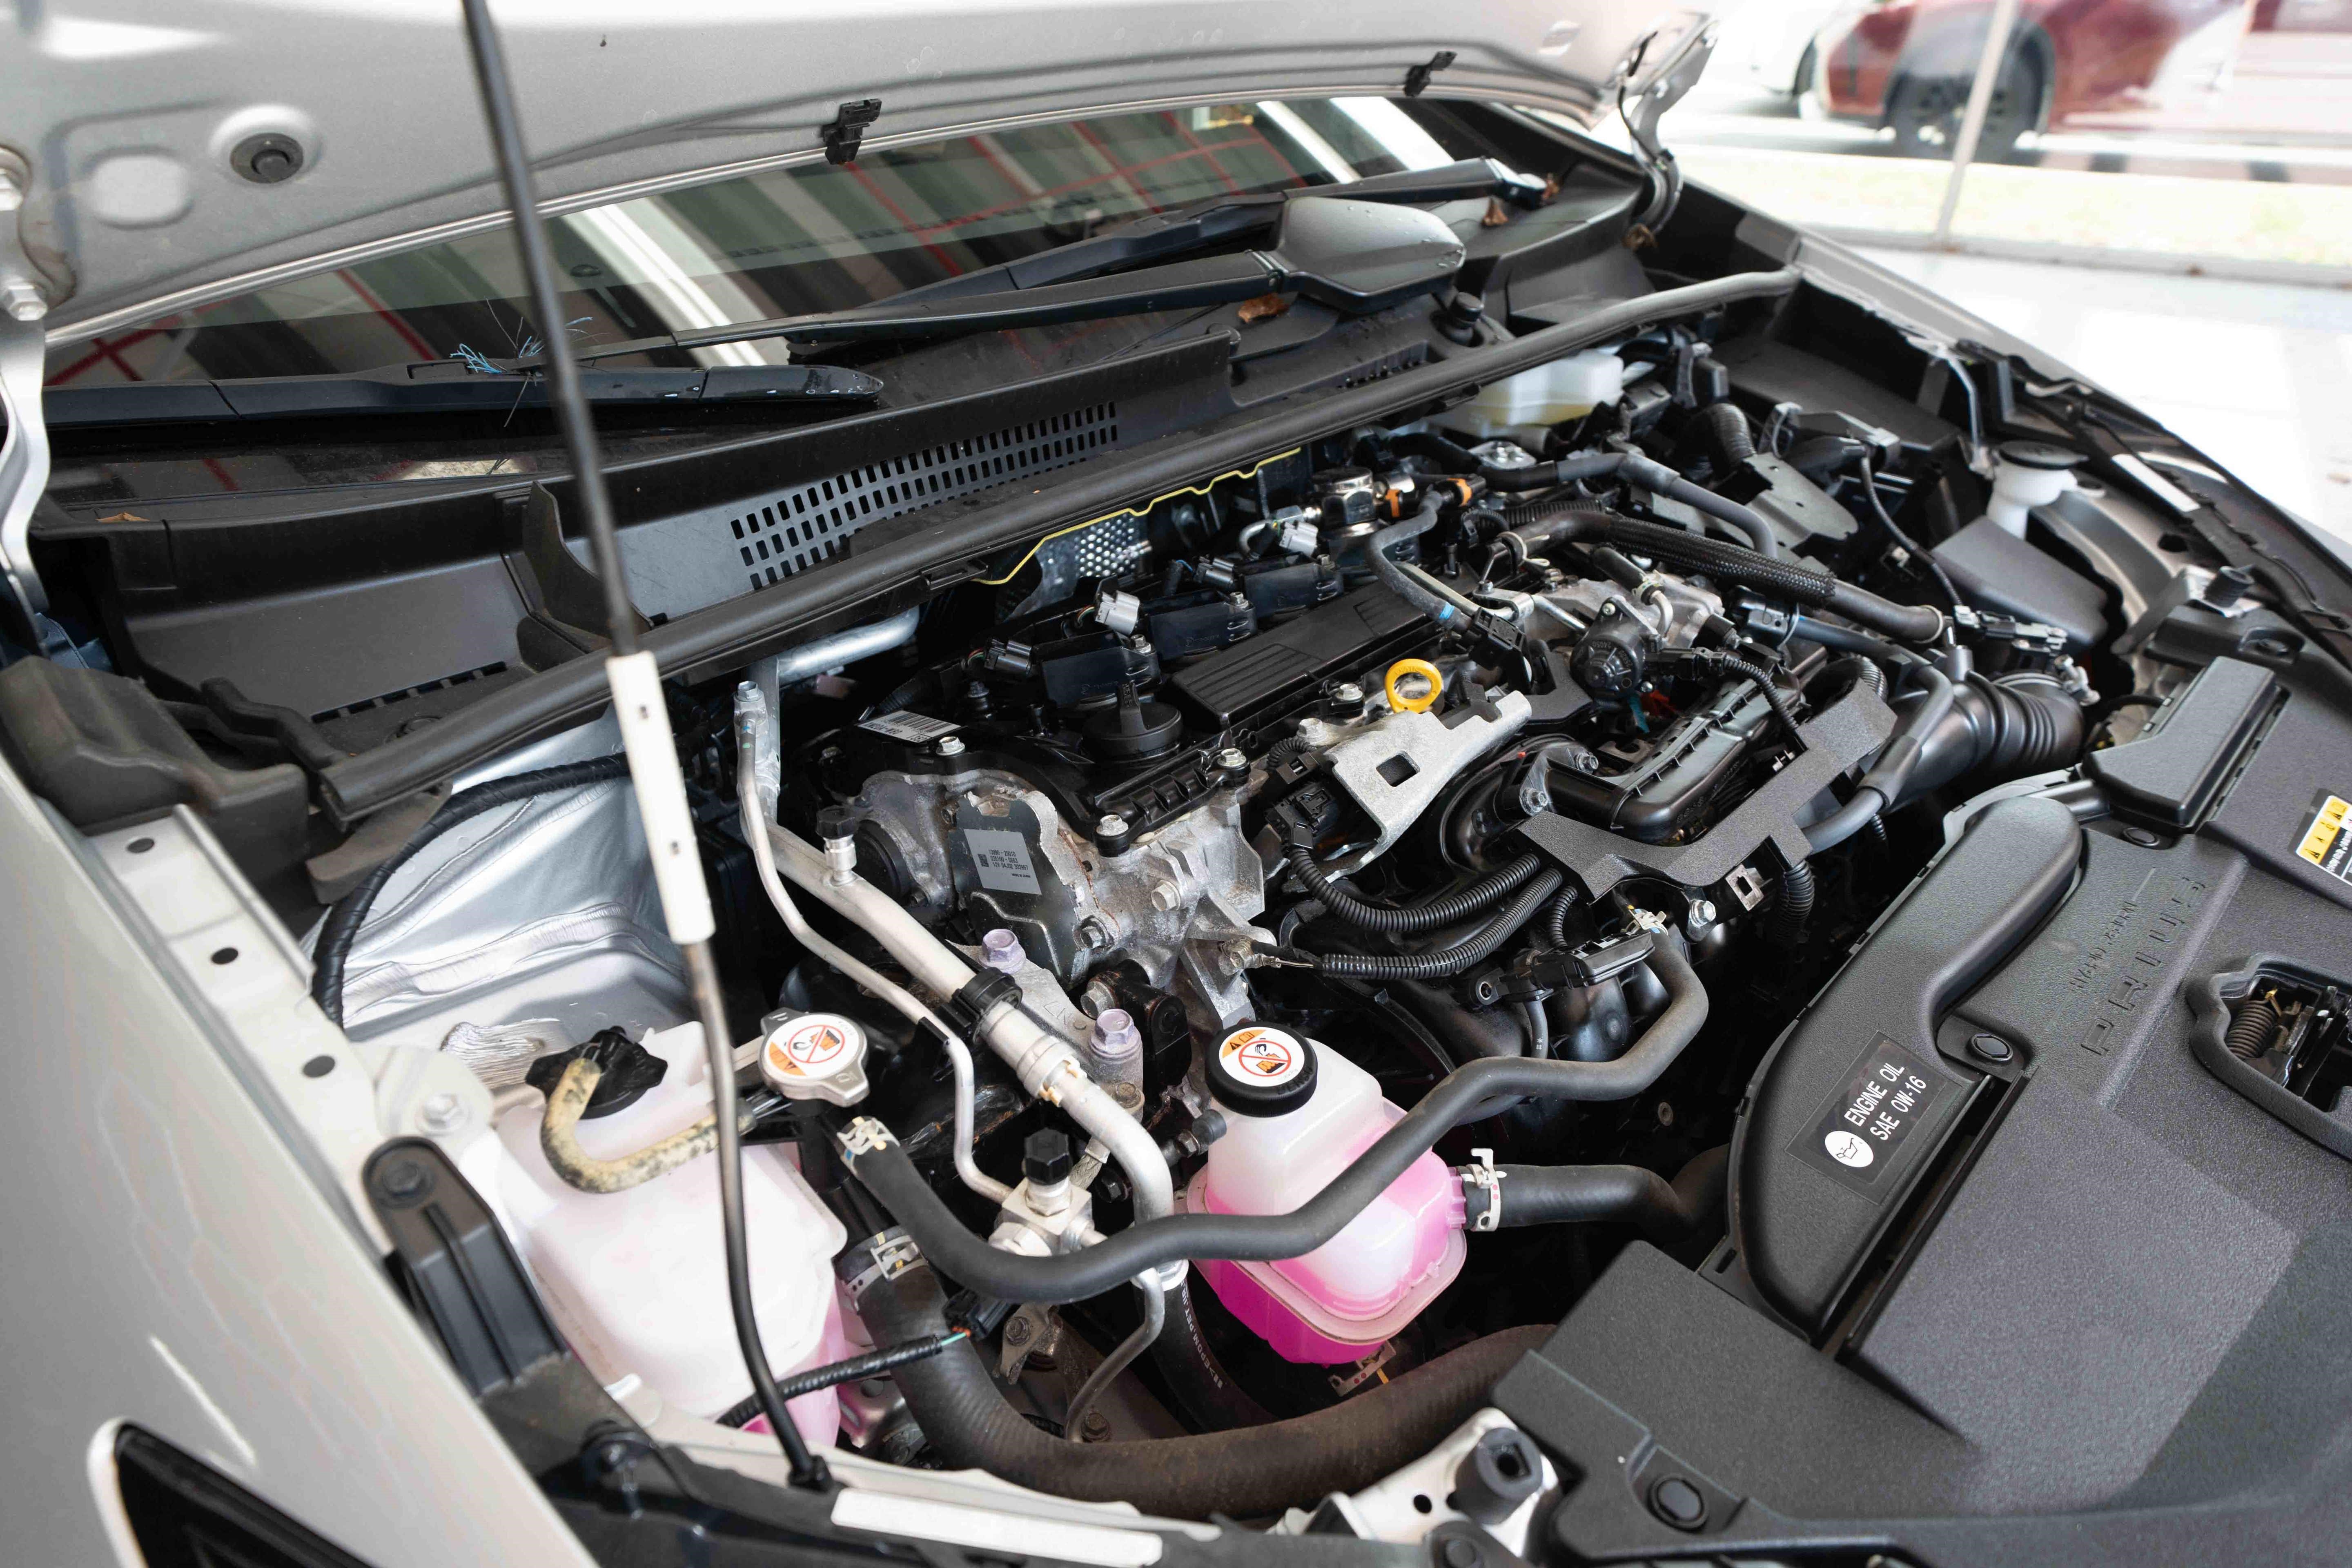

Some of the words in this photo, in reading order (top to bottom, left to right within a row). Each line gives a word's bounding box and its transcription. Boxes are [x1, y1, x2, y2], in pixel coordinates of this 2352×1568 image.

[1844, 1081, 1887, 1127] ENGINE
[1880, 1063, 1904, 1082] OIL
[1870, 1111, 1900, 1140] SAE
[1891, 1075, 1927, 1113] 0W-16
